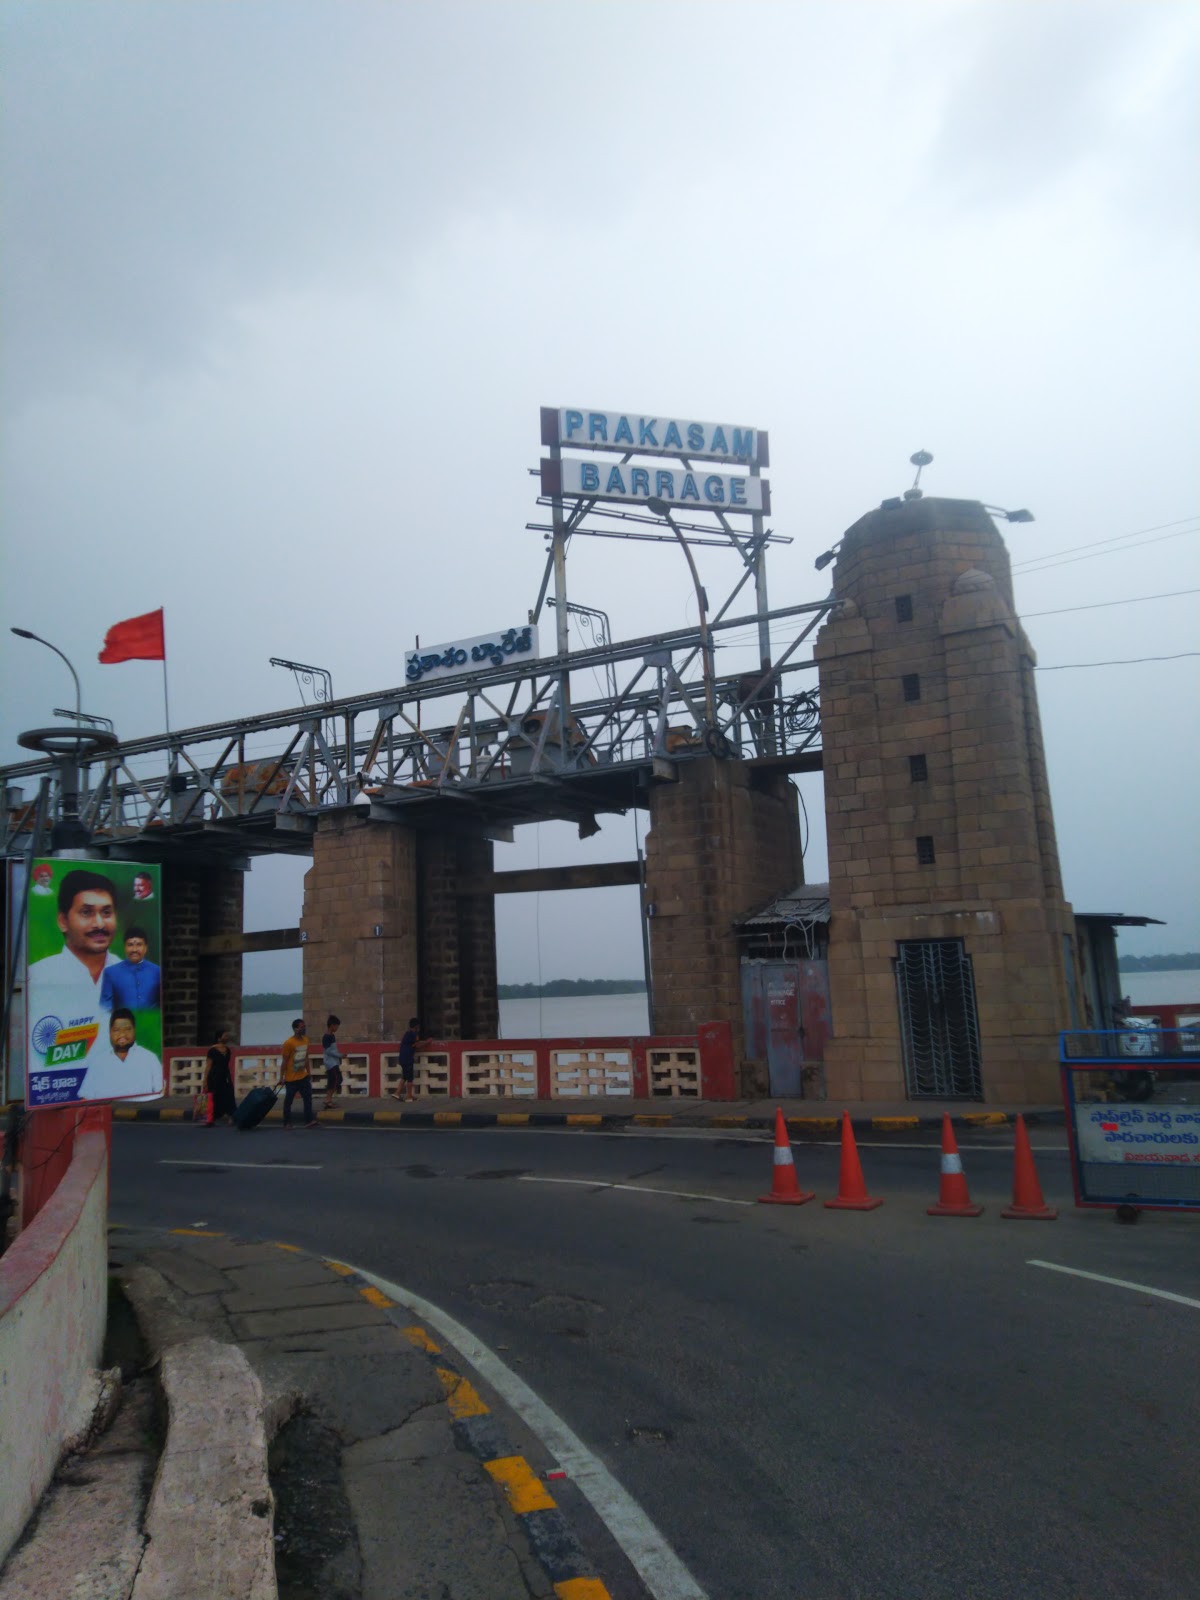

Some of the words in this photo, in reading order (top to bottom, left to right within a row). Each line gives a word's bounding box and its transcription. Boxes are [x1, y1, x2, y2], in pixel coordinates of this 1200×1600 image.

[565, 410, 753, 458] PRAKASAM
[580, 463, 747, 504] BARRAGE
[406, 646, 468, 682] ప్రకాశం
[301, 931, 307, 941] 2
[69, 1016, 94, 1026] HAPPY
[52, 1042, 82, 1062] DAY
